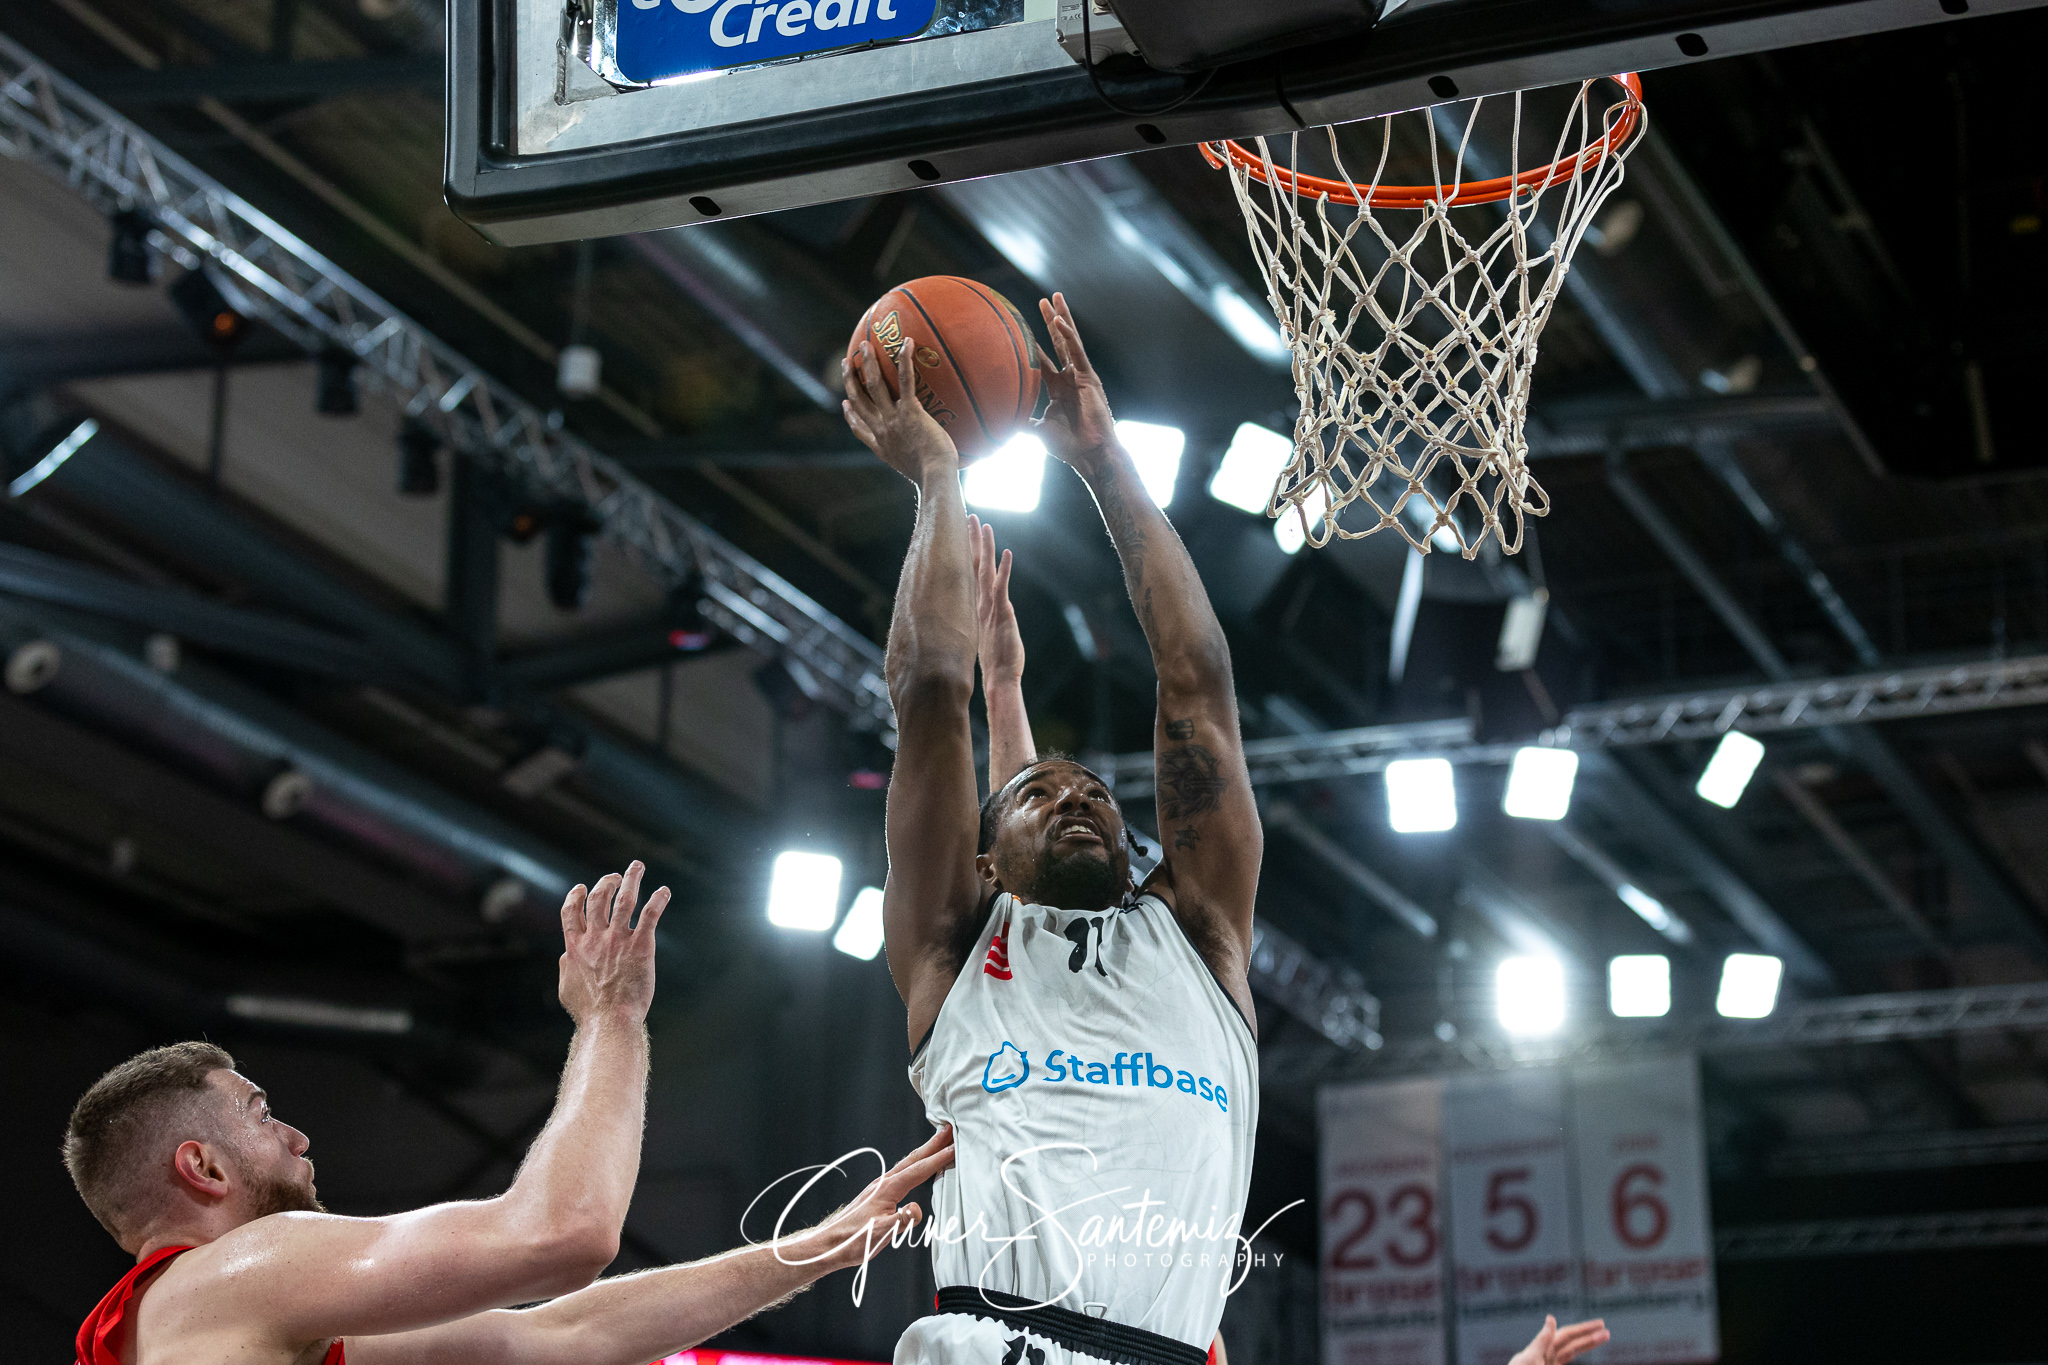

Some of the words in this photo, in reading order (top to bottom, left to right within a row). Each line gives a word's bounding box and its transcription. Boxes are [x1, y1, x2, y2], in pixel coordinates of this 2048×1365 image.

[1043, 1049, 1228, 1113] Staffbase
[1326, 1184, 1438, 1272] 23
[1484, 1166, 1540, 1253] 5
[1611, 1163, 1670, 1250] 6
